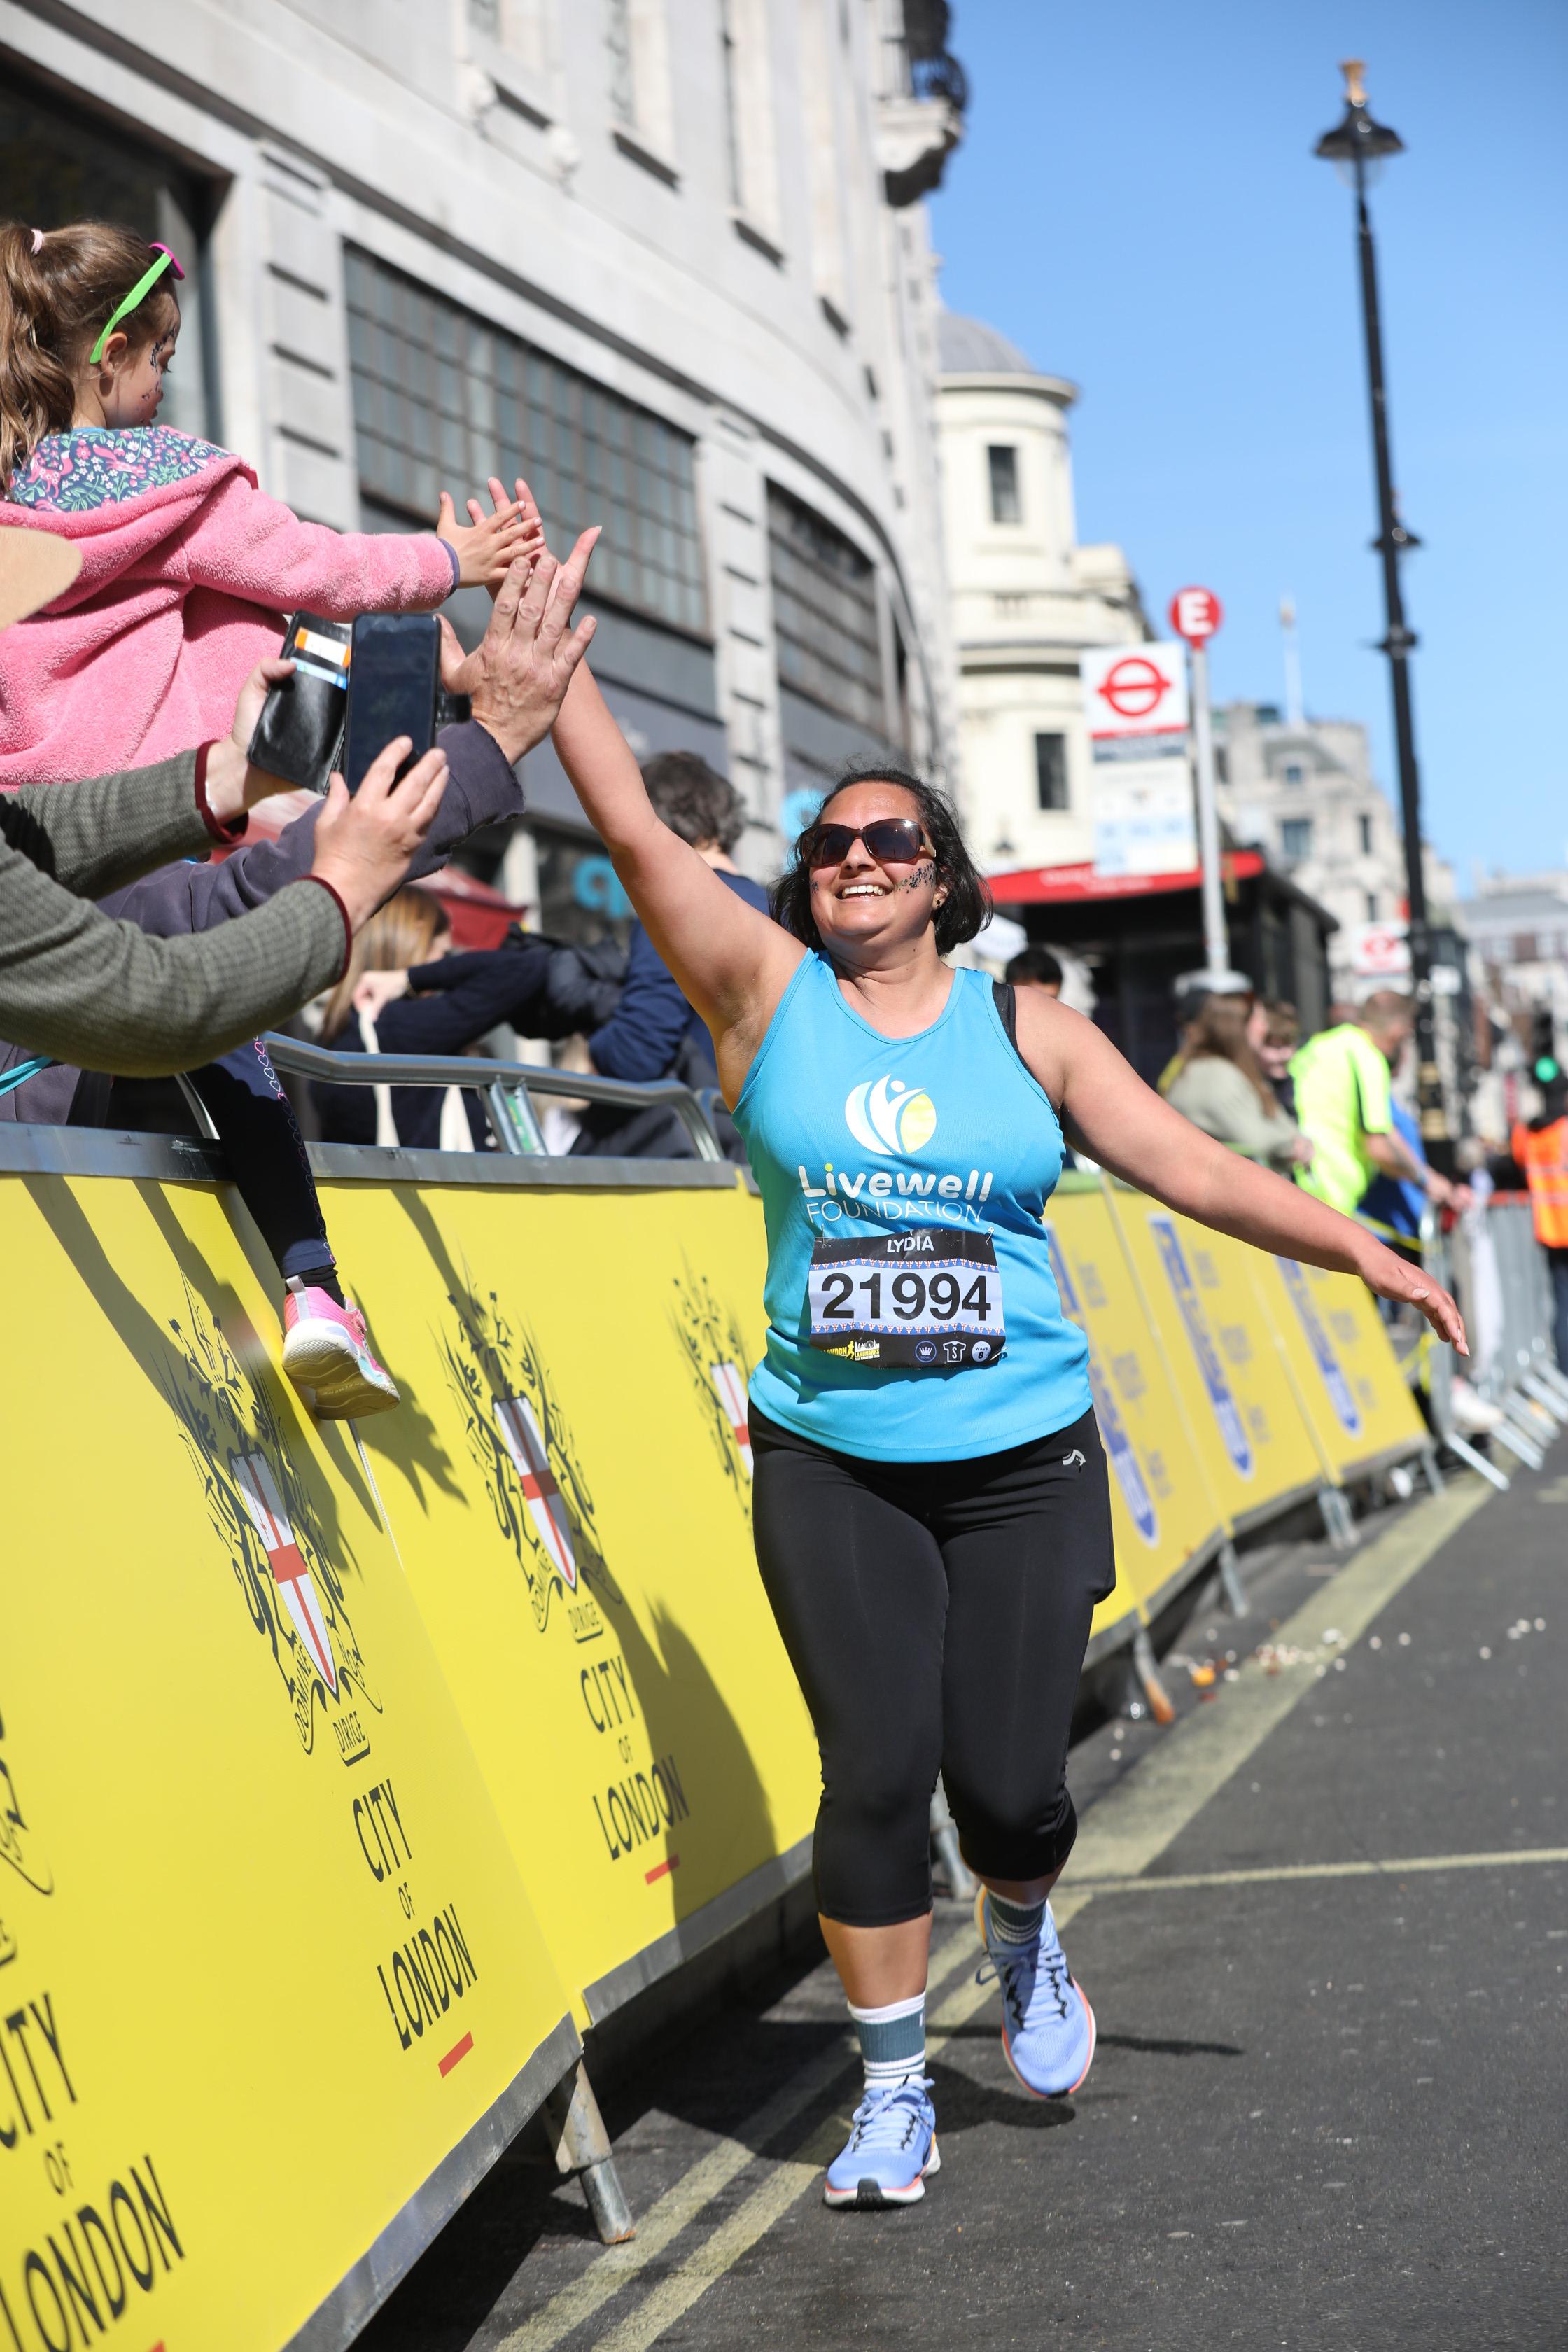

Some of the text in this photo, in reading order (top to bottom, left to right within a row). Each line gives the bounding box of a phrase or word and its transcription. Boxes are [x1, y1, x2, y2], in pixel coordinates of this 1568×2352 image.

[1179, 592, 1213, 636] E
[798, 1163, 993, 1202] Livewell
[806, 1200, 983, 1223] FOUNDATION
[886, 1236, 934, 1253] LYDIA
[821, 1272, 991, 1321] 21994
[824, 1346, 847, 1356] ONDON
[952, 1346, 957, 1359] S
[580, 1655, 635, 1733] CITY
[332, 1710, 366, 1754] DIRIGE
[619, 1735, 633, 1764] OF
[592, 1753, 690, 1861] LONDON
[353, 1778, 412, 1883] CITY
[398, 1882, 415, 1921] OF
[376, 1903, 477, 2052] LONDON
[0, 1991, 78, 2150] ITY
[43, 2141, 74, 2197] OF
